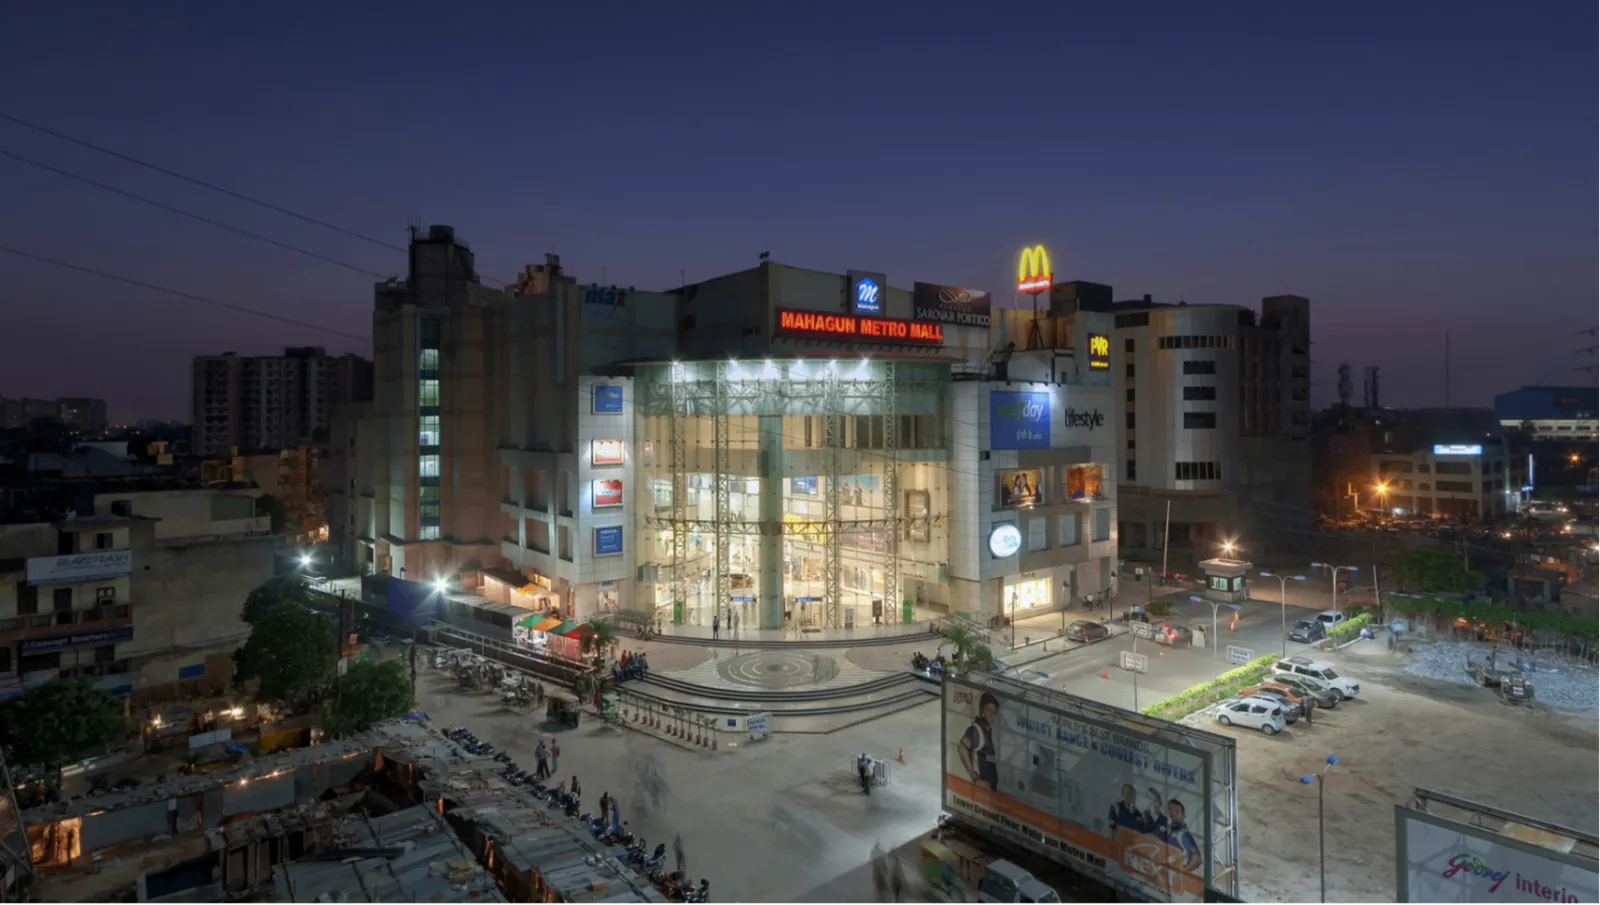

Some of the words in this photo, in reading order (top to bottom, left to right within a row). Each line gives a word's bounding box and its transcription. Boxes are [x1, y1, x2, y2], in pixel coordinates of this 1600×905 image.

[780, 311, 856, 333] MAHAGUN
[860, 318, 907, 337] METRO
[910, 323, 943, 340] MALL
[916, 307, 955, 322] SAROVAR
[956, 313, 991, 326] PORTICO
[1090, 335, 1109, 356] PVR
[1064, 407, 1104, 431] lifestyle
[1100, 742, 1150, 769] COOLEST
[1060, 840, 1085, 861] Metro
[1087, 851, 1106, 869] Mall
